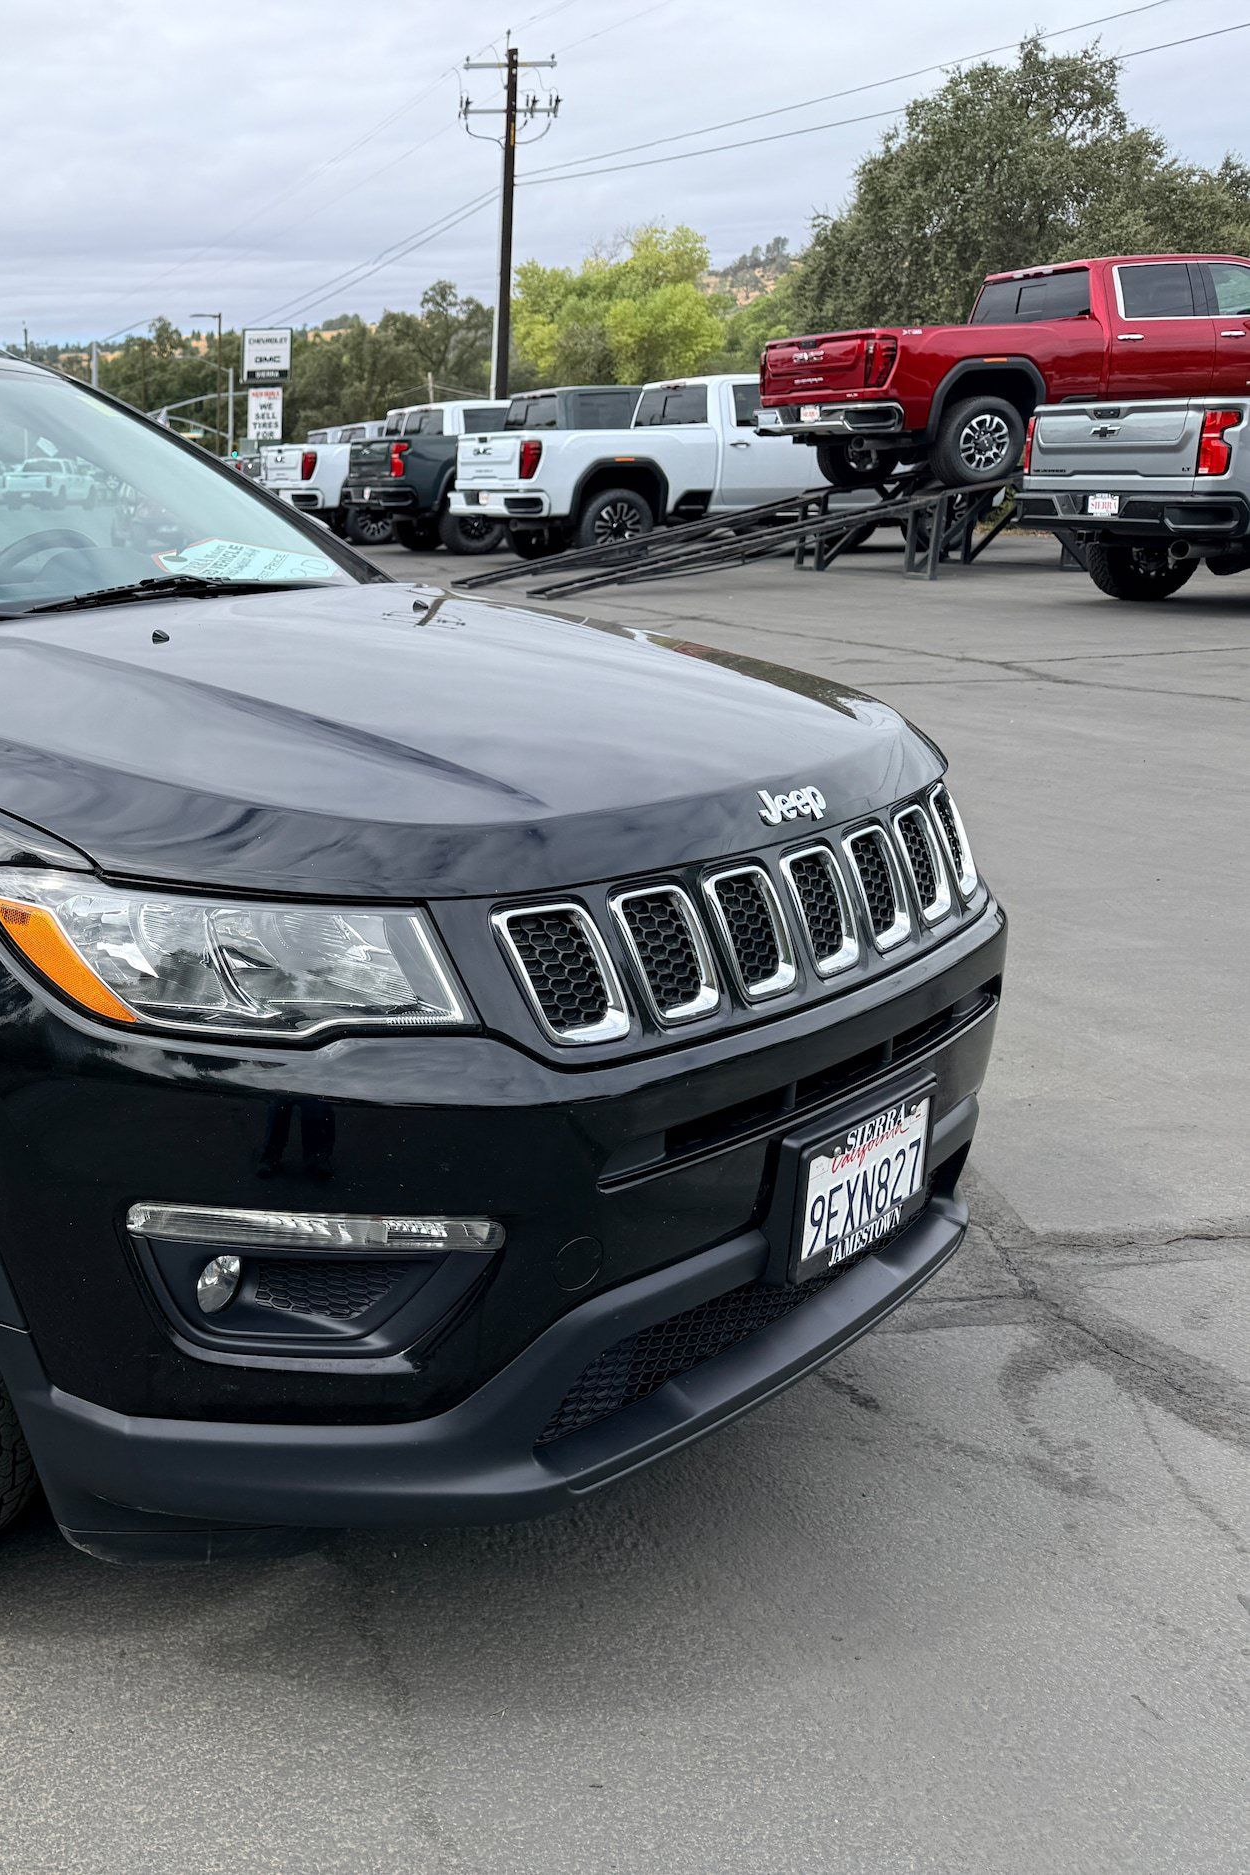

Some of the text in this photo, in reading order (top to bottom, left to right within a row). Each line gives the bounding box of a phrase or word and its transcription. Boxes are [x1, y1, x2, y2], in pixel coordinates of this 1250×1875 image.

[248, 337, 288, 345] CHEVROLET
[255, 412, 277, 420] SELL
[259, 402, 273, 410] WE
[252, 422, 279, 430] TIRES
[757, 786, 827, 824] Jeep
[845, 1104, 906, 1153] SIERRA
[807, 1137, 922, 1257] 9EXN827
[828, 1204, 904, 1267] JAMESTOWN
